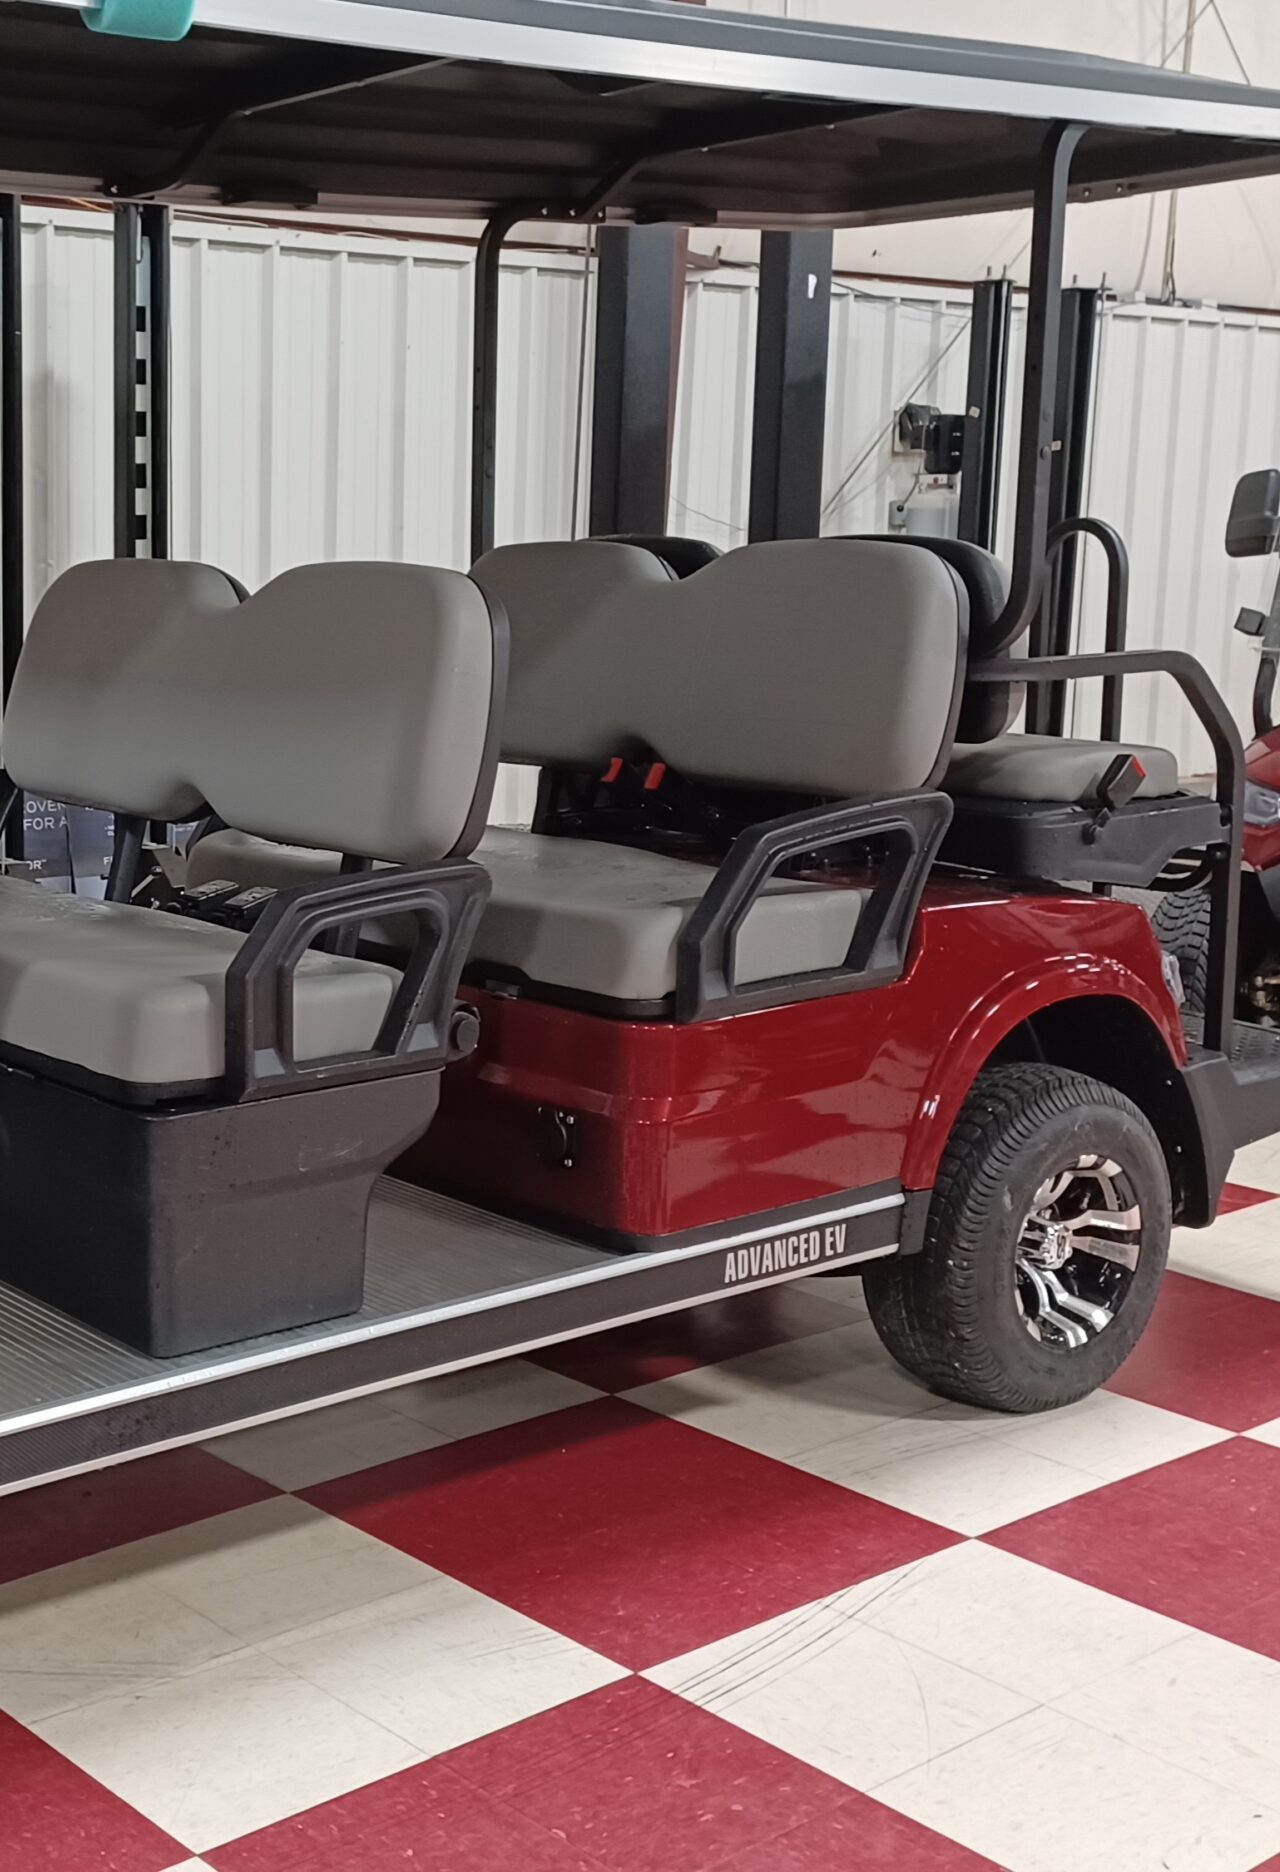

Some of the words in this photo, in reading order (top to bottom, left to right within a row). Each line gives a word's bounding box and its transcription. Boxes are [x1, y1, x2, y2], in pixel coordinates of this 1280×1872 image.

[23, 817, 55, 831] FOR
[724, 1230, 821, 1284] ADVANCED
[824, 1223, 847, 1257] EV
